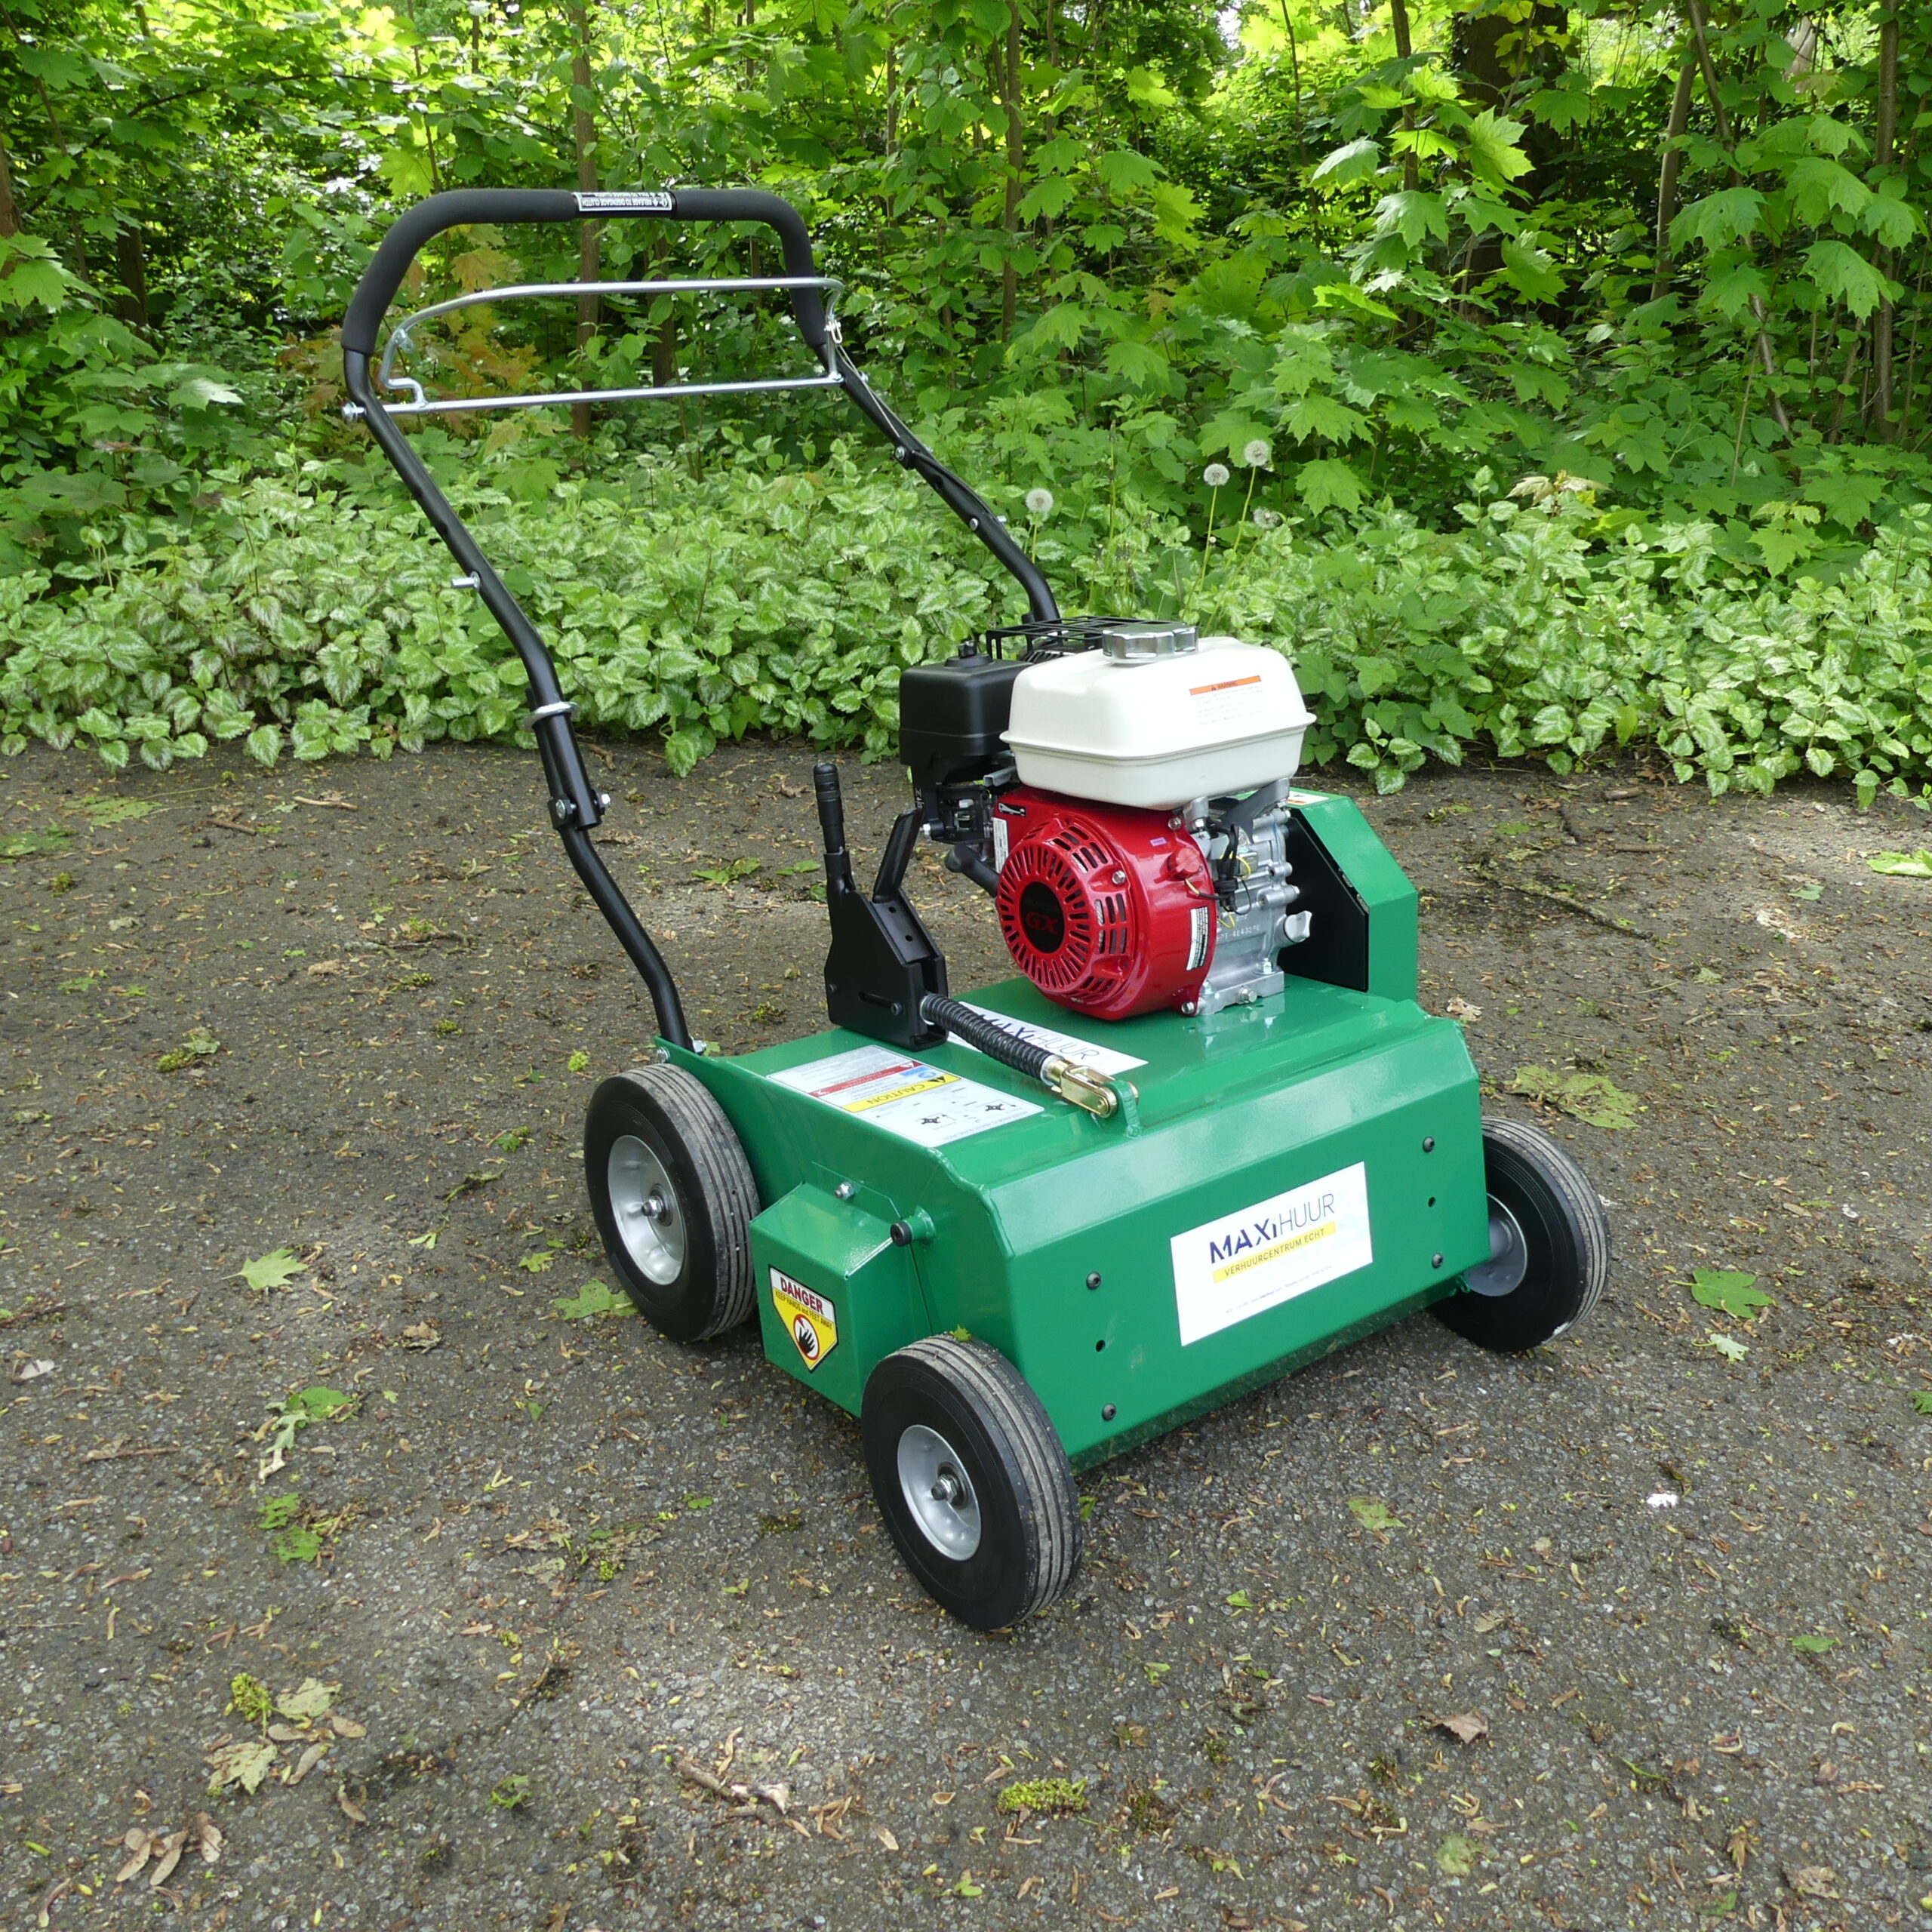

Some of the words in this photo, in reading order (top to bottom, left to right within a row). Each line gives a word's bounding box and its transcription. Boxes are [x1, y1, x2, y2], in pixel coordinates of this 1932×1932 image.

[1026, 912, 1060, 935] GX
[866, 1084, 925, 1104] CAUTION
[1224, 1238, 1303, 1276] VERHUURCENTRUM
[1304, 1228, 1325, 1244] ECHT
[775, 1291, 786, 1301] KEEP
[786, 1297, 801, 1312] HANDS
[810, 1310, 820, 1321] FEET
[820, 1318, 832, 1330] AWAY
[780, 1276, 824, 1315] DANGER
